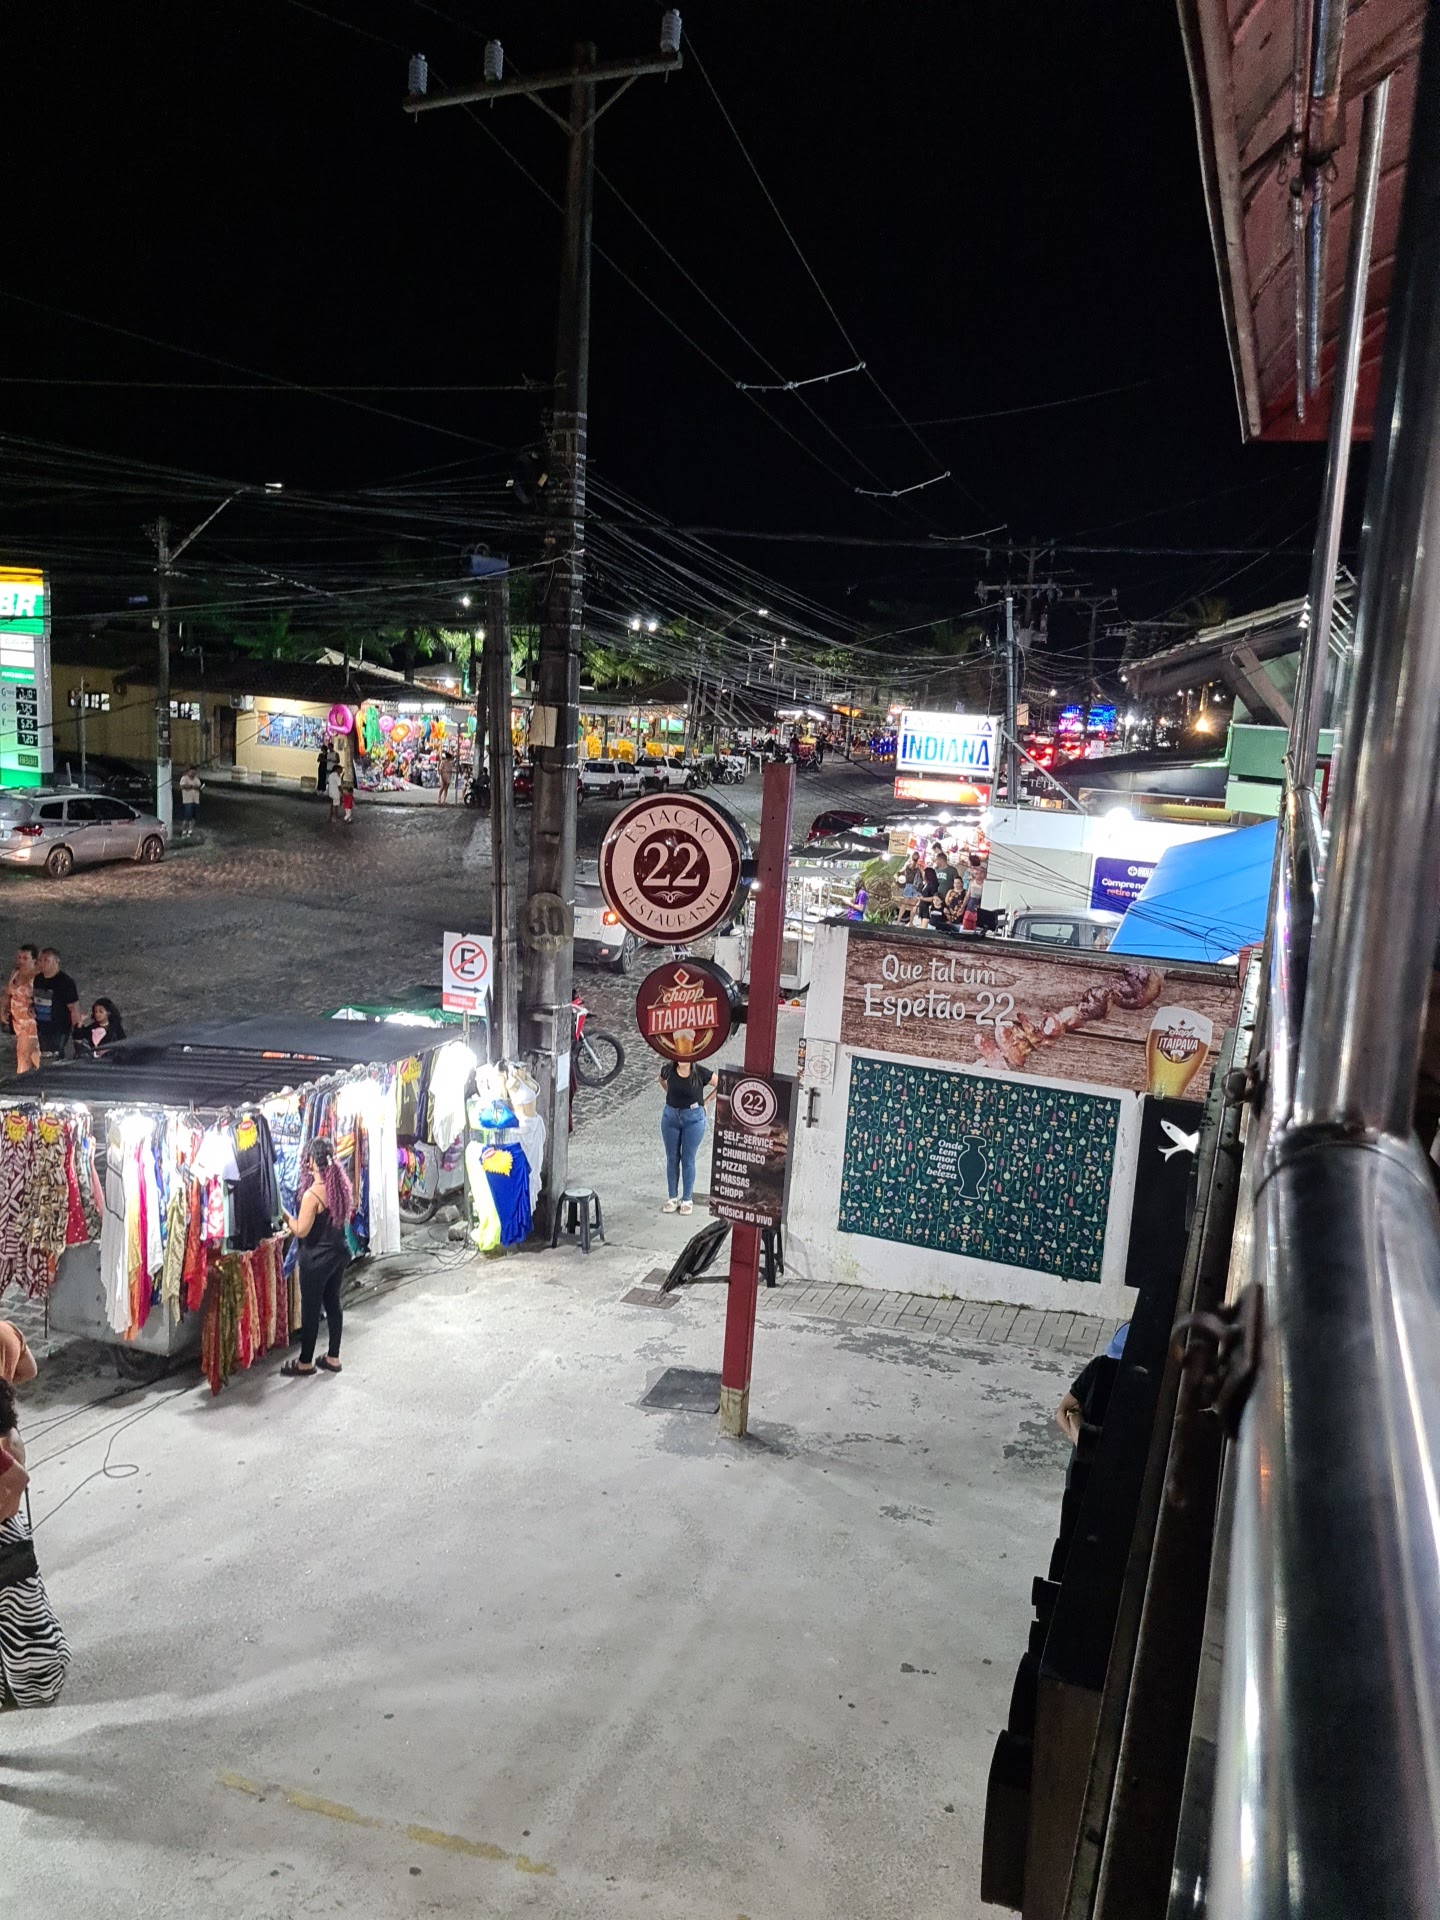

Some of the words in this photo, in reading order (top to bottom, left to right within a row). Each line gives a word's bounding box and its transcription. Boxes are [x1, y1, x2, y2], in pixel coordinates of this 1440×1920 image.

[0, 592, 35, 616] BR
[902, 733, 990, 766] INDIANA
[625, 810, 715, 843] ESTAÇÃO
[642, 842, 701, 887] 22
[1101, 878, 1135, 891] Compre
[1106, 888, 1131, 897] retire
[622, 887, 722, 928] RESTAURANTE
[460, 948, 476, 975] E
[882, 954, 923, 983] Que
[928, 957, 956, 983] tal
[963, 967, 996, 986] um
[663, 986, 705, 1004] chopp
[863, 982, 966, 1026] Espetão
[975, 991, 1015, 1027] 22
[651, 1003, 716, 1032] ITAIPAVA
[1158, 1037, 1199, 1051] ITAIPAVA
[743, 1092, 764, 1111] 22
[723, 1129, 774, 1149] SELF-SERVICE
[938, 1139, 963, 1151] Onde
[722, 1147, 766, 1165] CHURRASCO
[929, 1154, 957, 1164] amor
[939, 1148, 957, 1157] tem
[721, 1160, 748, 1174] PIZZAS
[926, 1167, 957, 1180] beleza
[936, 1162, 956, 1171] tem
[720, 1173, 750, 1188] MASSAS
[719, 1185, 744, 1199] CHOPP
[718, 1205, 744, 1221] MÚSICA
[745, 1212, 755, 1222] AO
[756, 1213, 773, 1226] VIVO
